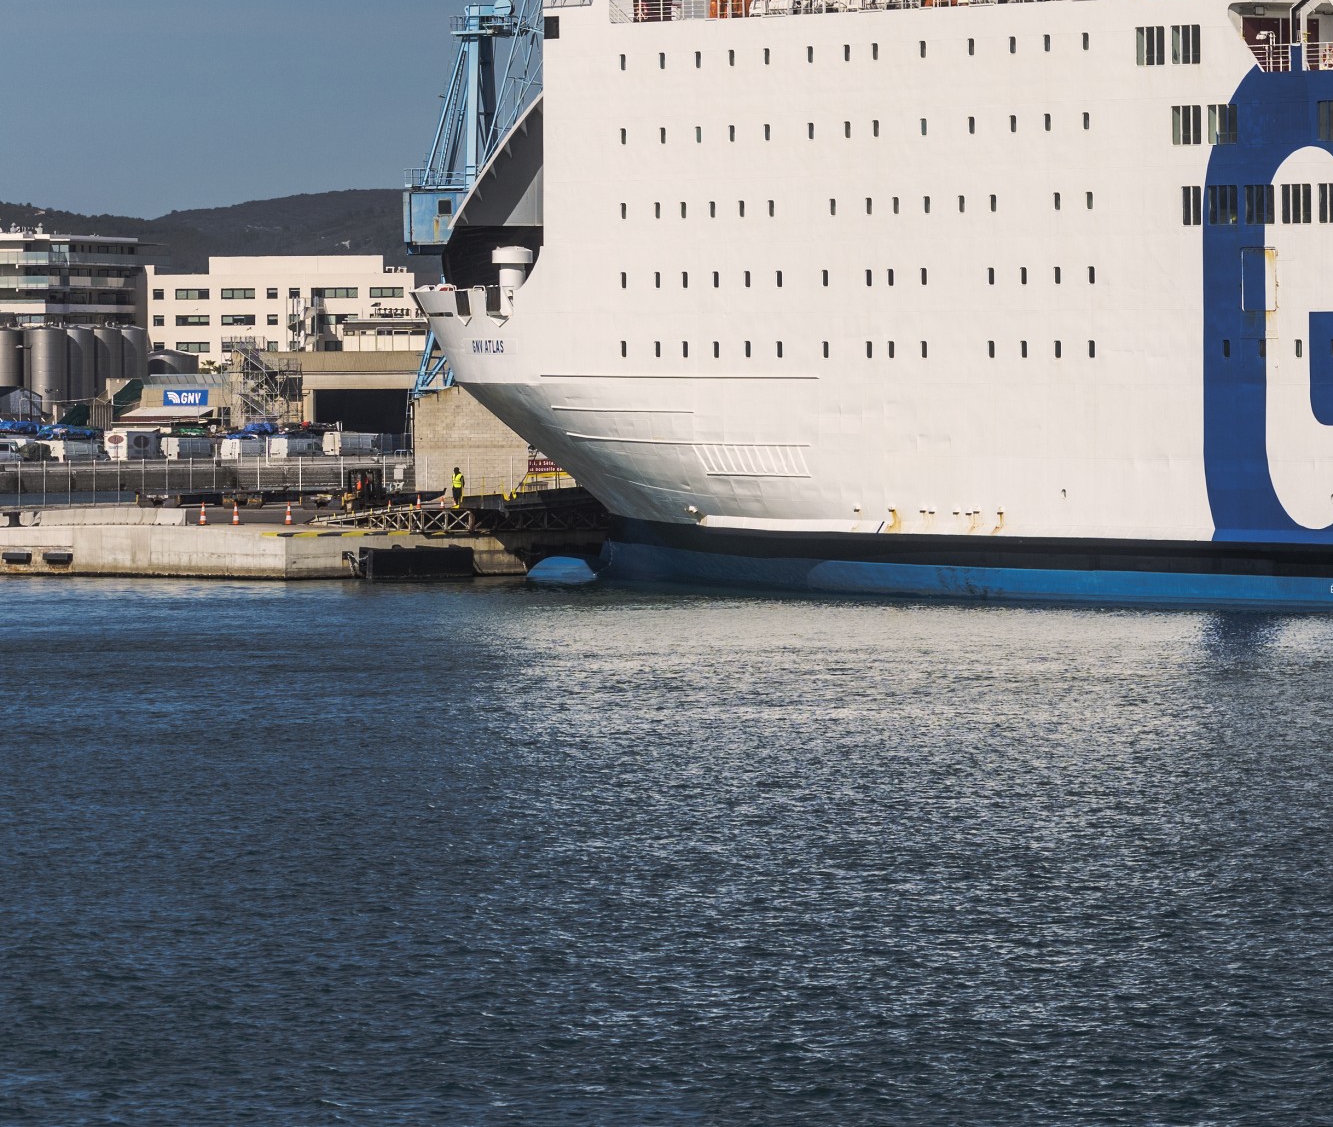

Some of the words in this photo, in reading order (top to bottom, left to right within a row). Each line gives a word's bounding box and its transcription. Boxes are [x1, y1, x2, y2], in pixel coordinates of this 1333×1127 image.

[472, 340, 483, 353] GNV
[485, 340, 504, 353] ATLAS
[181, 392, 201, 404] GNV
